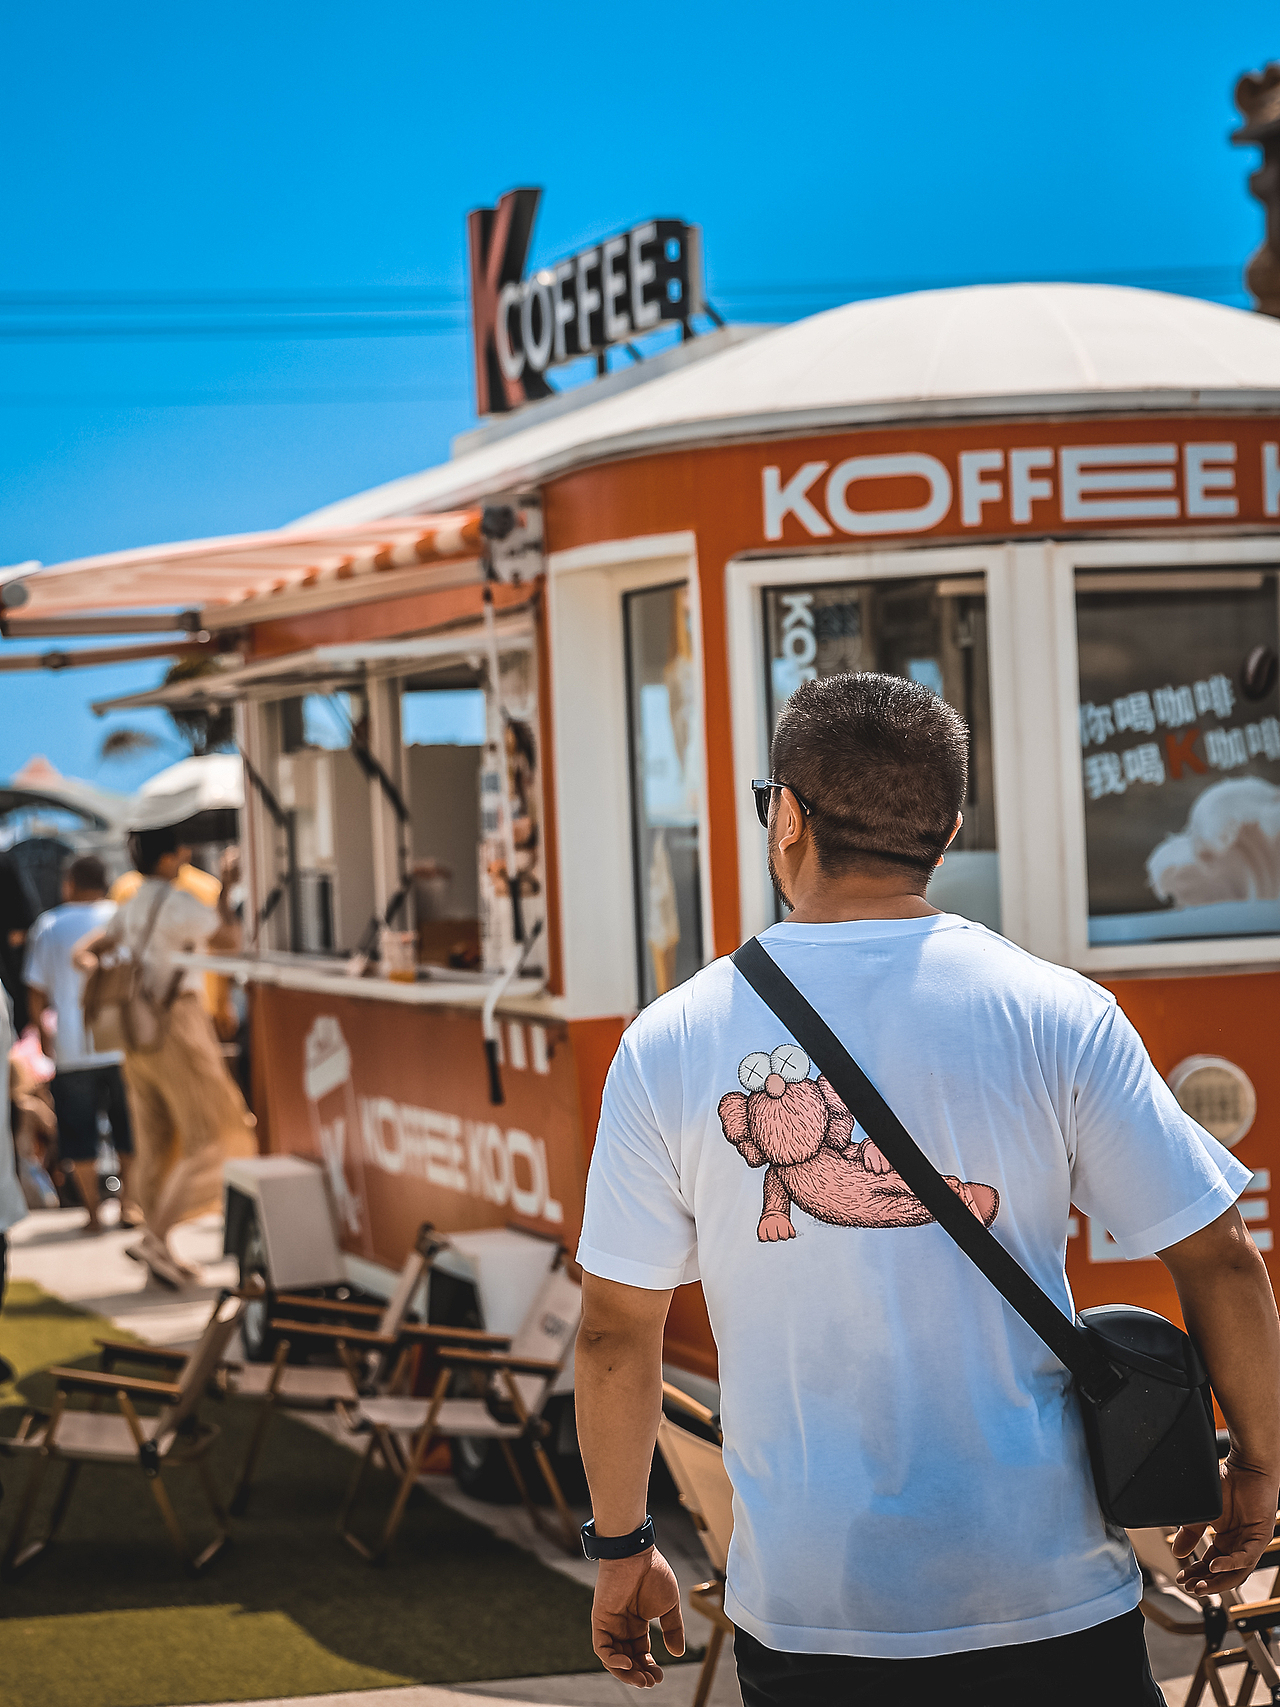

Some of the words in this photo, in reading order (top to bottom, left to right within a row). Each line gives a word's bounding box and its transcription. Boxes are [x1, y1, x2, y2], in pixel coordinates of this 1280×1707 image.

[495, 221, 660, 382] COFFEE
[761, 441, 1239, 541] KOFFEE
[782, 593, 817, 684] KO
[1080, 673, 1236, 748] 你喝咖啡
